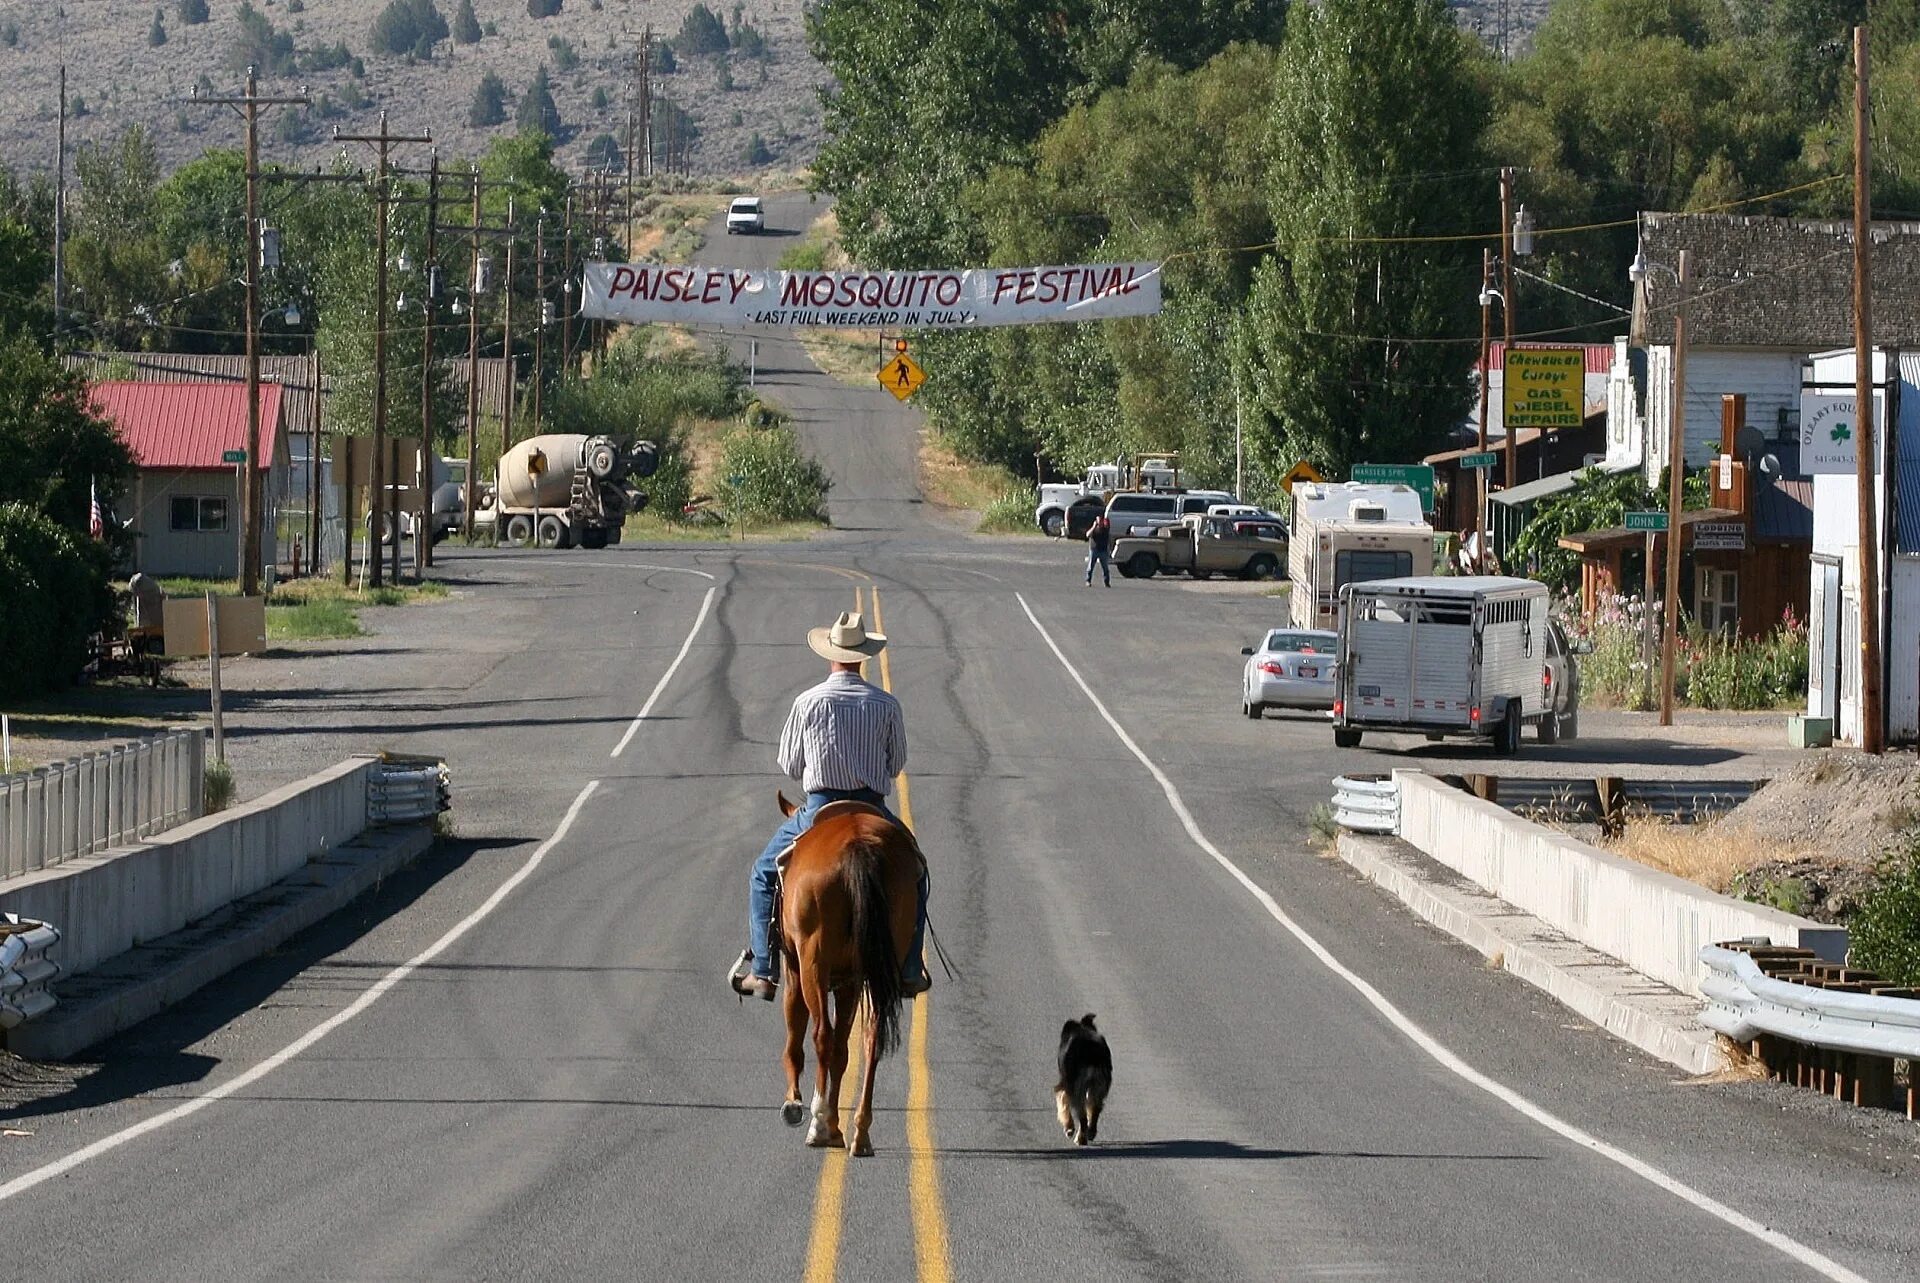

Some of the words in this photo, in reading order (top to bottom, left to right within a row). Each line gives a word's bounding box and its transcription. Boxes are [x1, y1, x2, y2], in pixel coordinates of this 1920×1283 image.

[608, 267, 751, 305] PAISLEY
[780, 275, 961, 308] MOSQUITO
[992, 266, 1141, 306] FESTIVAL
[755, 310, 787, 324] LAST
[790, 311, 821, 325] FULL
[826, 311, 899, 326] WEEKEND
[905, 311, 919, 324] IN
[926, 310, 970, 325] JULY
[1527, 388, 1562, 398] GAS
[1628, 516, 1655, 528] JOHN
